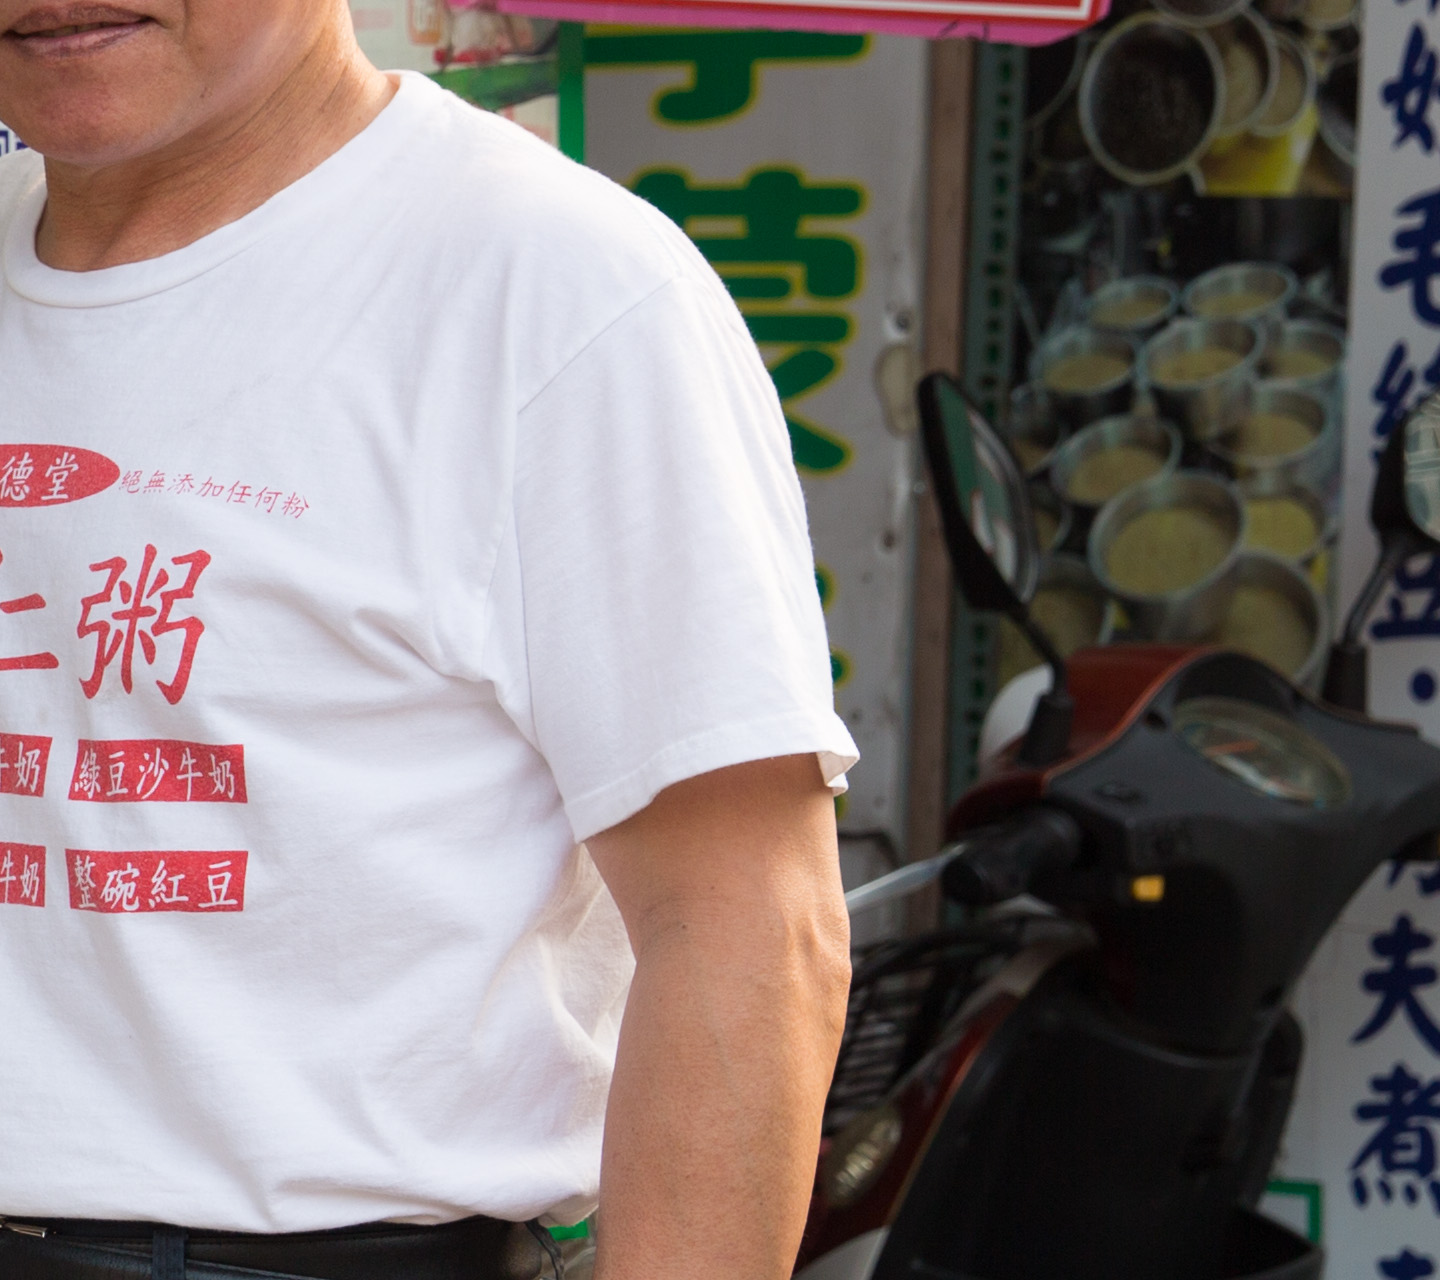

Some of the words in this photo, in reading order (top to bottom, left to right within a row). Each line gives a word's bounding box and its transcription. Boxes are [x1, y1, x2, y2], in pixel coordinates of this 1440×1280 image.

[120, 469, 311, 520] 絕無添加任何粉
[74, 750, 238, 800] 綠豆沙牛奶
[74, 858, 238, 911] 整碗紅豆
